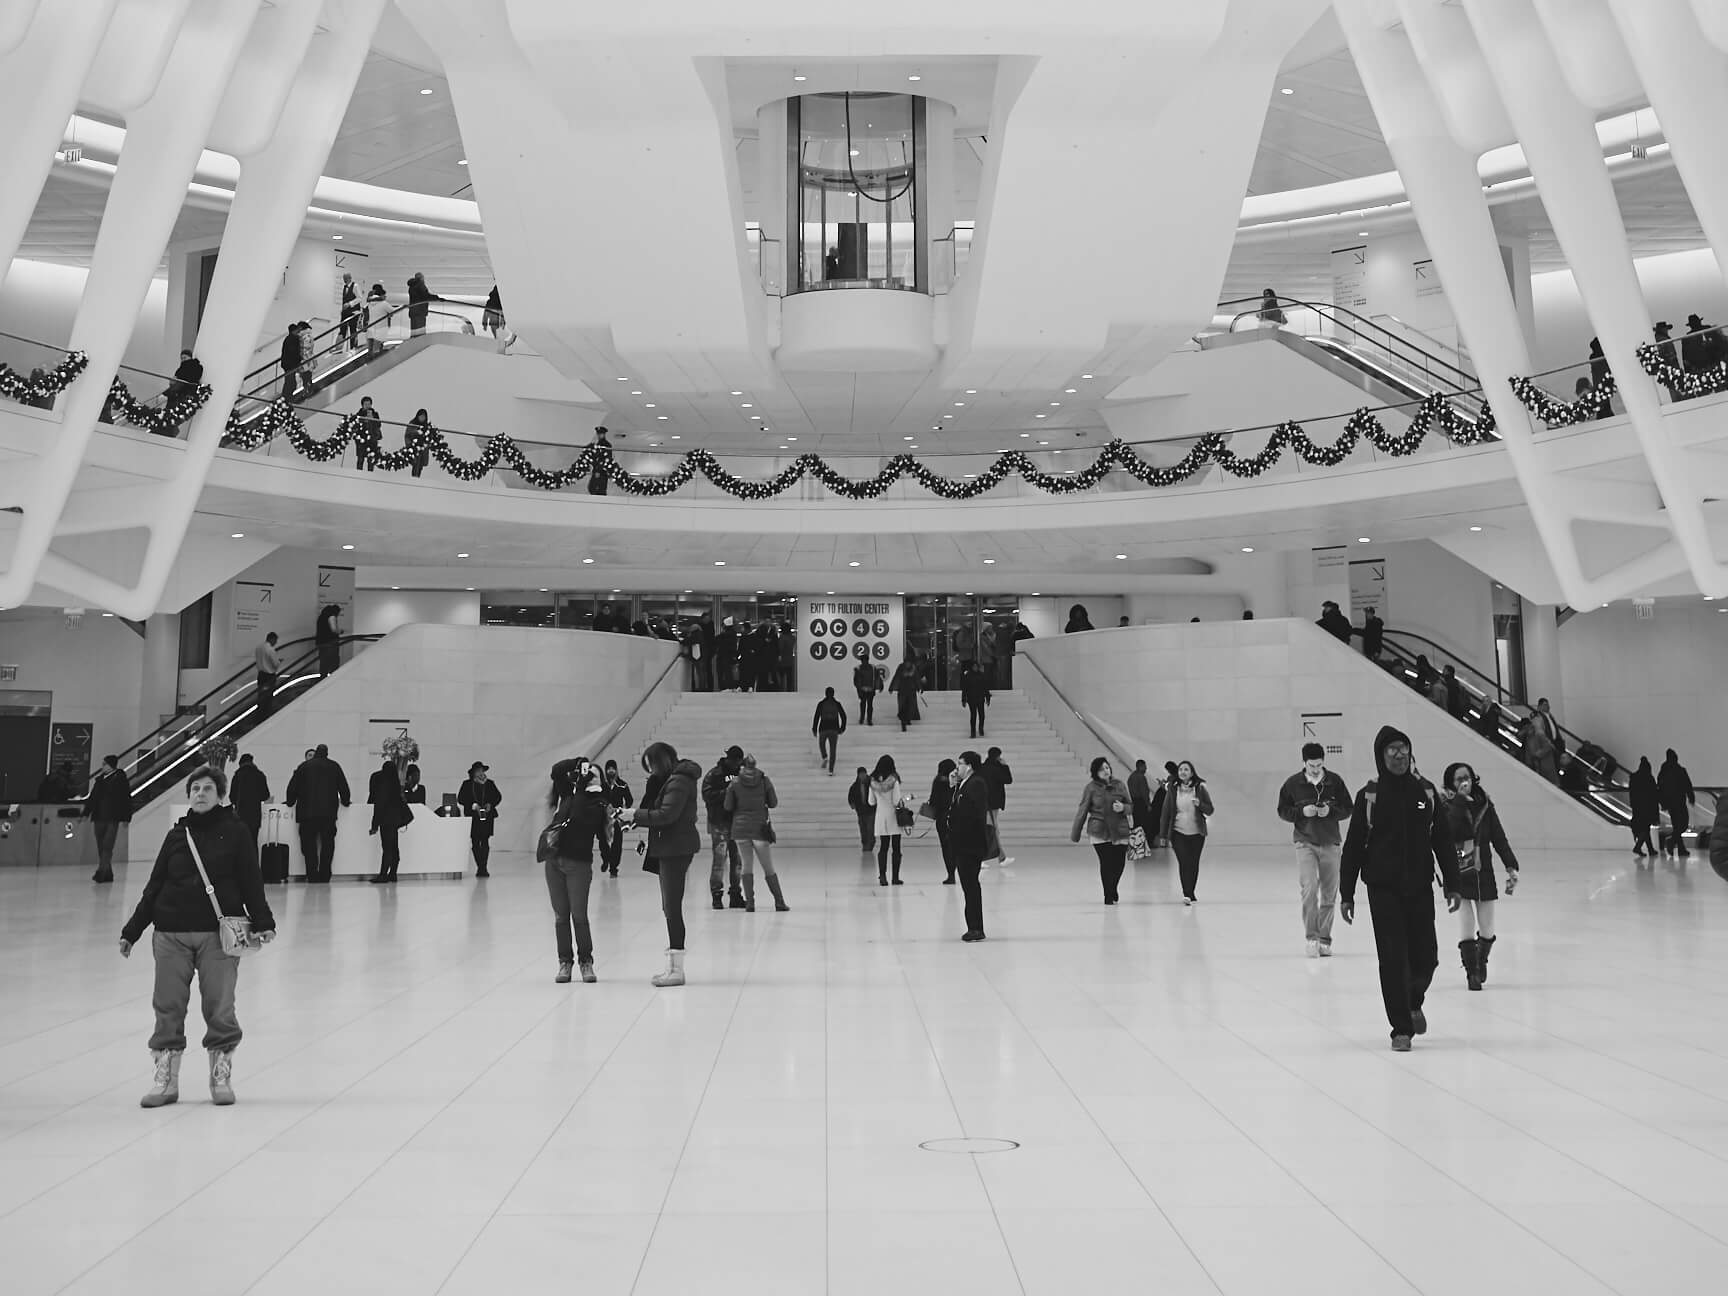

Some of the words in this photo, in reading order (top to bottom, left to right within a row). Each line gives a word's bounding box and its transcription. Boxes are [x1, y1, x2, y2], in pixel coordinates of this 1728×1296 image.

[810, 603, 825, 614] EXIT
[828, 603, 836, 614] TO
[838, 603, 863, 615] FULTON
[864, 603, 890, 615] CENTER
